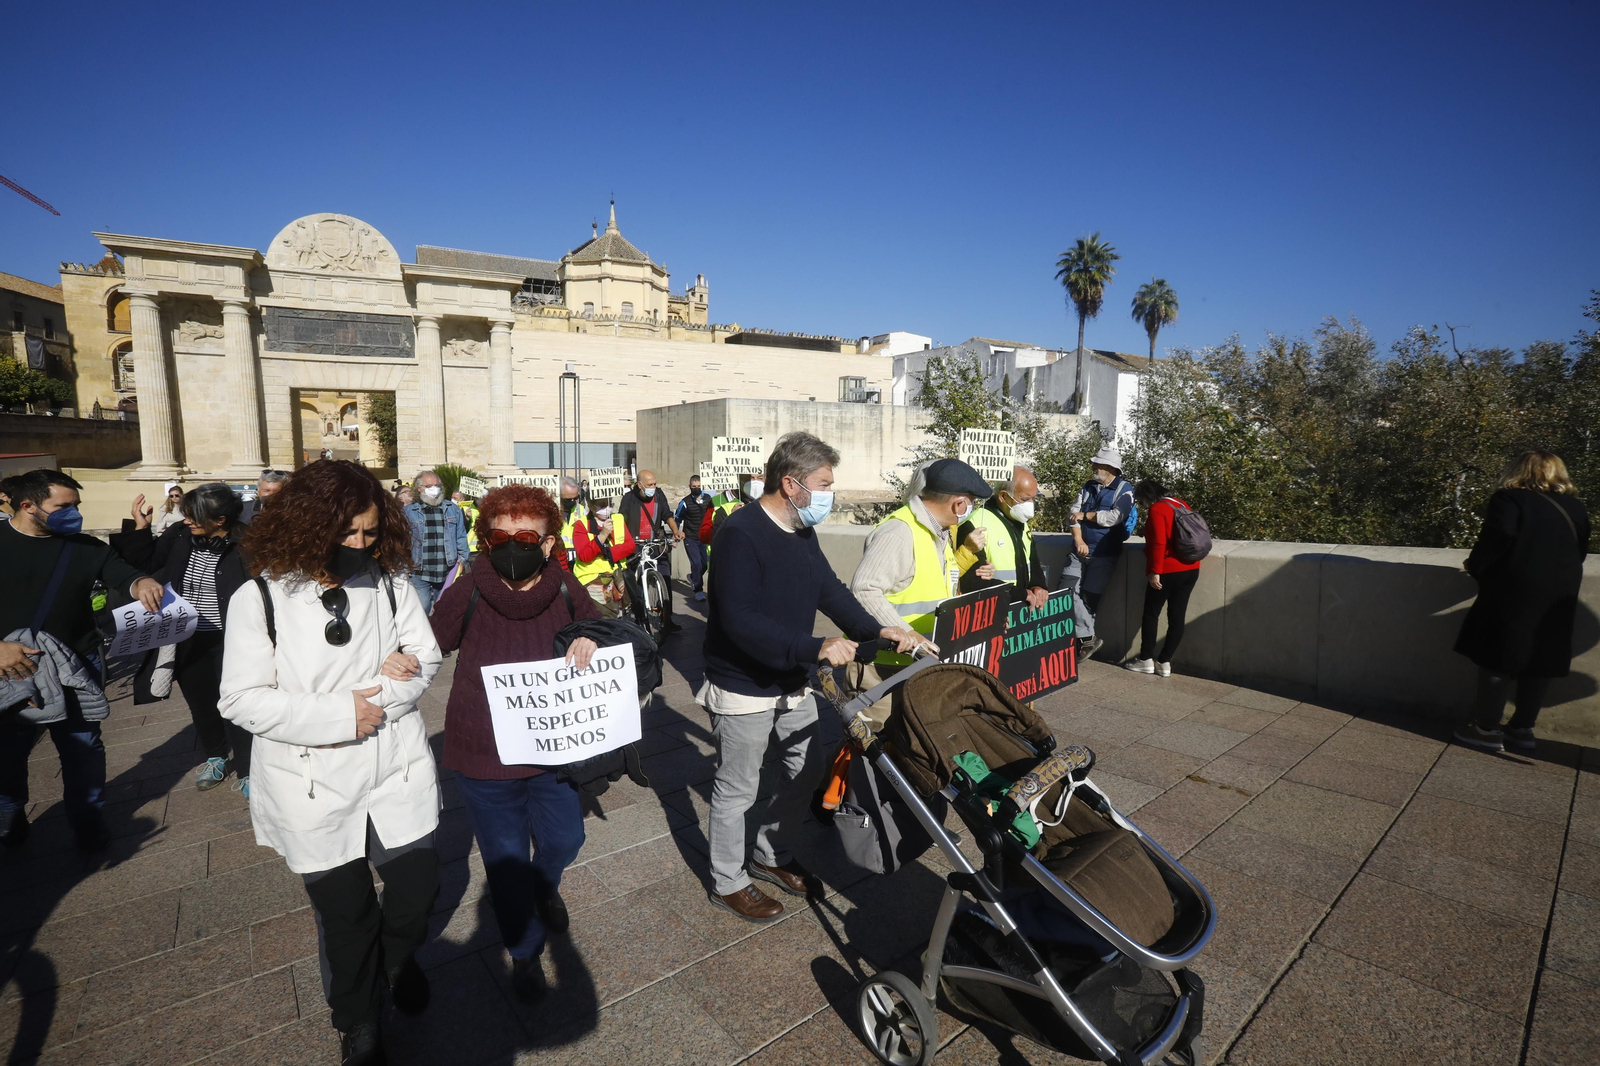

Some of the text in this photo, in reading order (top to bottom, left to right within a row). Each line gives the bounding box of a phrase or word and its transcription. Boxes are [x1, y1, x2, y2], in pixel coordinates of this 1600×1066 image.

[963, 430, 1015, 444] POLÍTICAS
[716, 444, 760, 452] MEJOR
[962, 443, 1014, 457] CONTRA EL
[725, 458, 751, 466] VIVIR
[967, 455, 1008, 468] CAMBIO
[591, 468, 622, 476] TRANSPORTE
[713, 465, 730, 473] CON
[733, 466, 762, 474] MENOS
[500, 476, 558, 486] EDUCACIÓN
[594, 477, 620, 487] PÚBLICO
[592, 486, 624, 500] LIMPIO
[1020, 594, 1072, 625] CAMBIO
[951, 596, 998, 641] NO HAY
[1002, 618, 1074, 658] CLIMÁTICO
[493, 656, 625, 689] NI UN GRADO
[1016, 638, 1076, 700] ESTÁ AQUÍ
[505, 679, 622, 710] MÁS NI UNA
[526, 704, 609, 731] ESPECIE
[535, 727, 606, 752] MENOS
